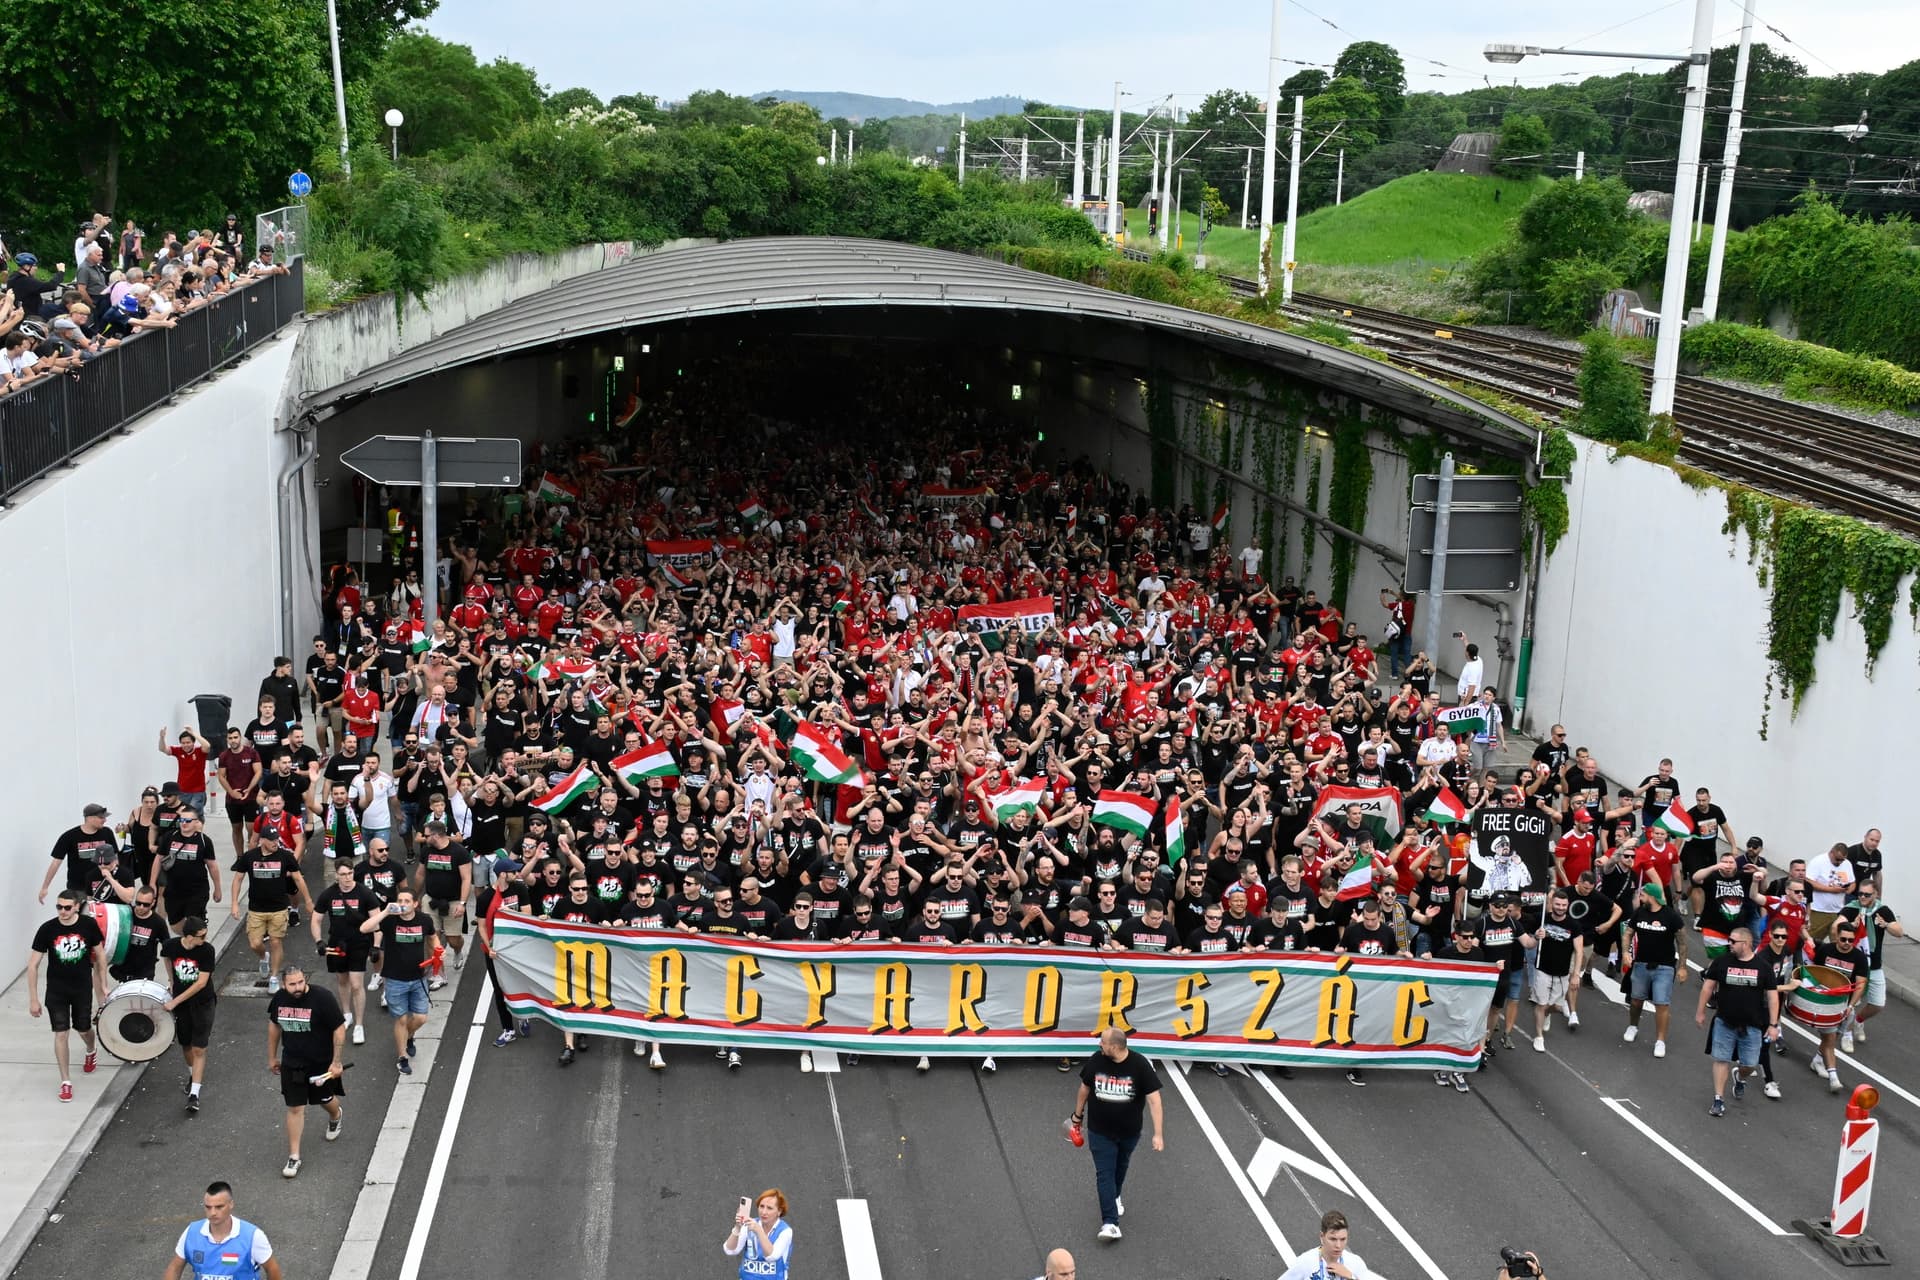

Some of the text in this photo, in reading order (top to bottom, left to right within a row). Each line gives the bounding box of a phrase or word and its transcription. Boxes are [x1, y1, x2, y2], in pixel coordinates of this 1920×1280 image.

[1335, 801, 1382, 812] ADA
[1482, 813, 1545, 835] FREE GiGi!
[1715, 885, 1745, 899] LEGENDS
[551, 940, 1434, 1048] MAGYARORSZÁG
